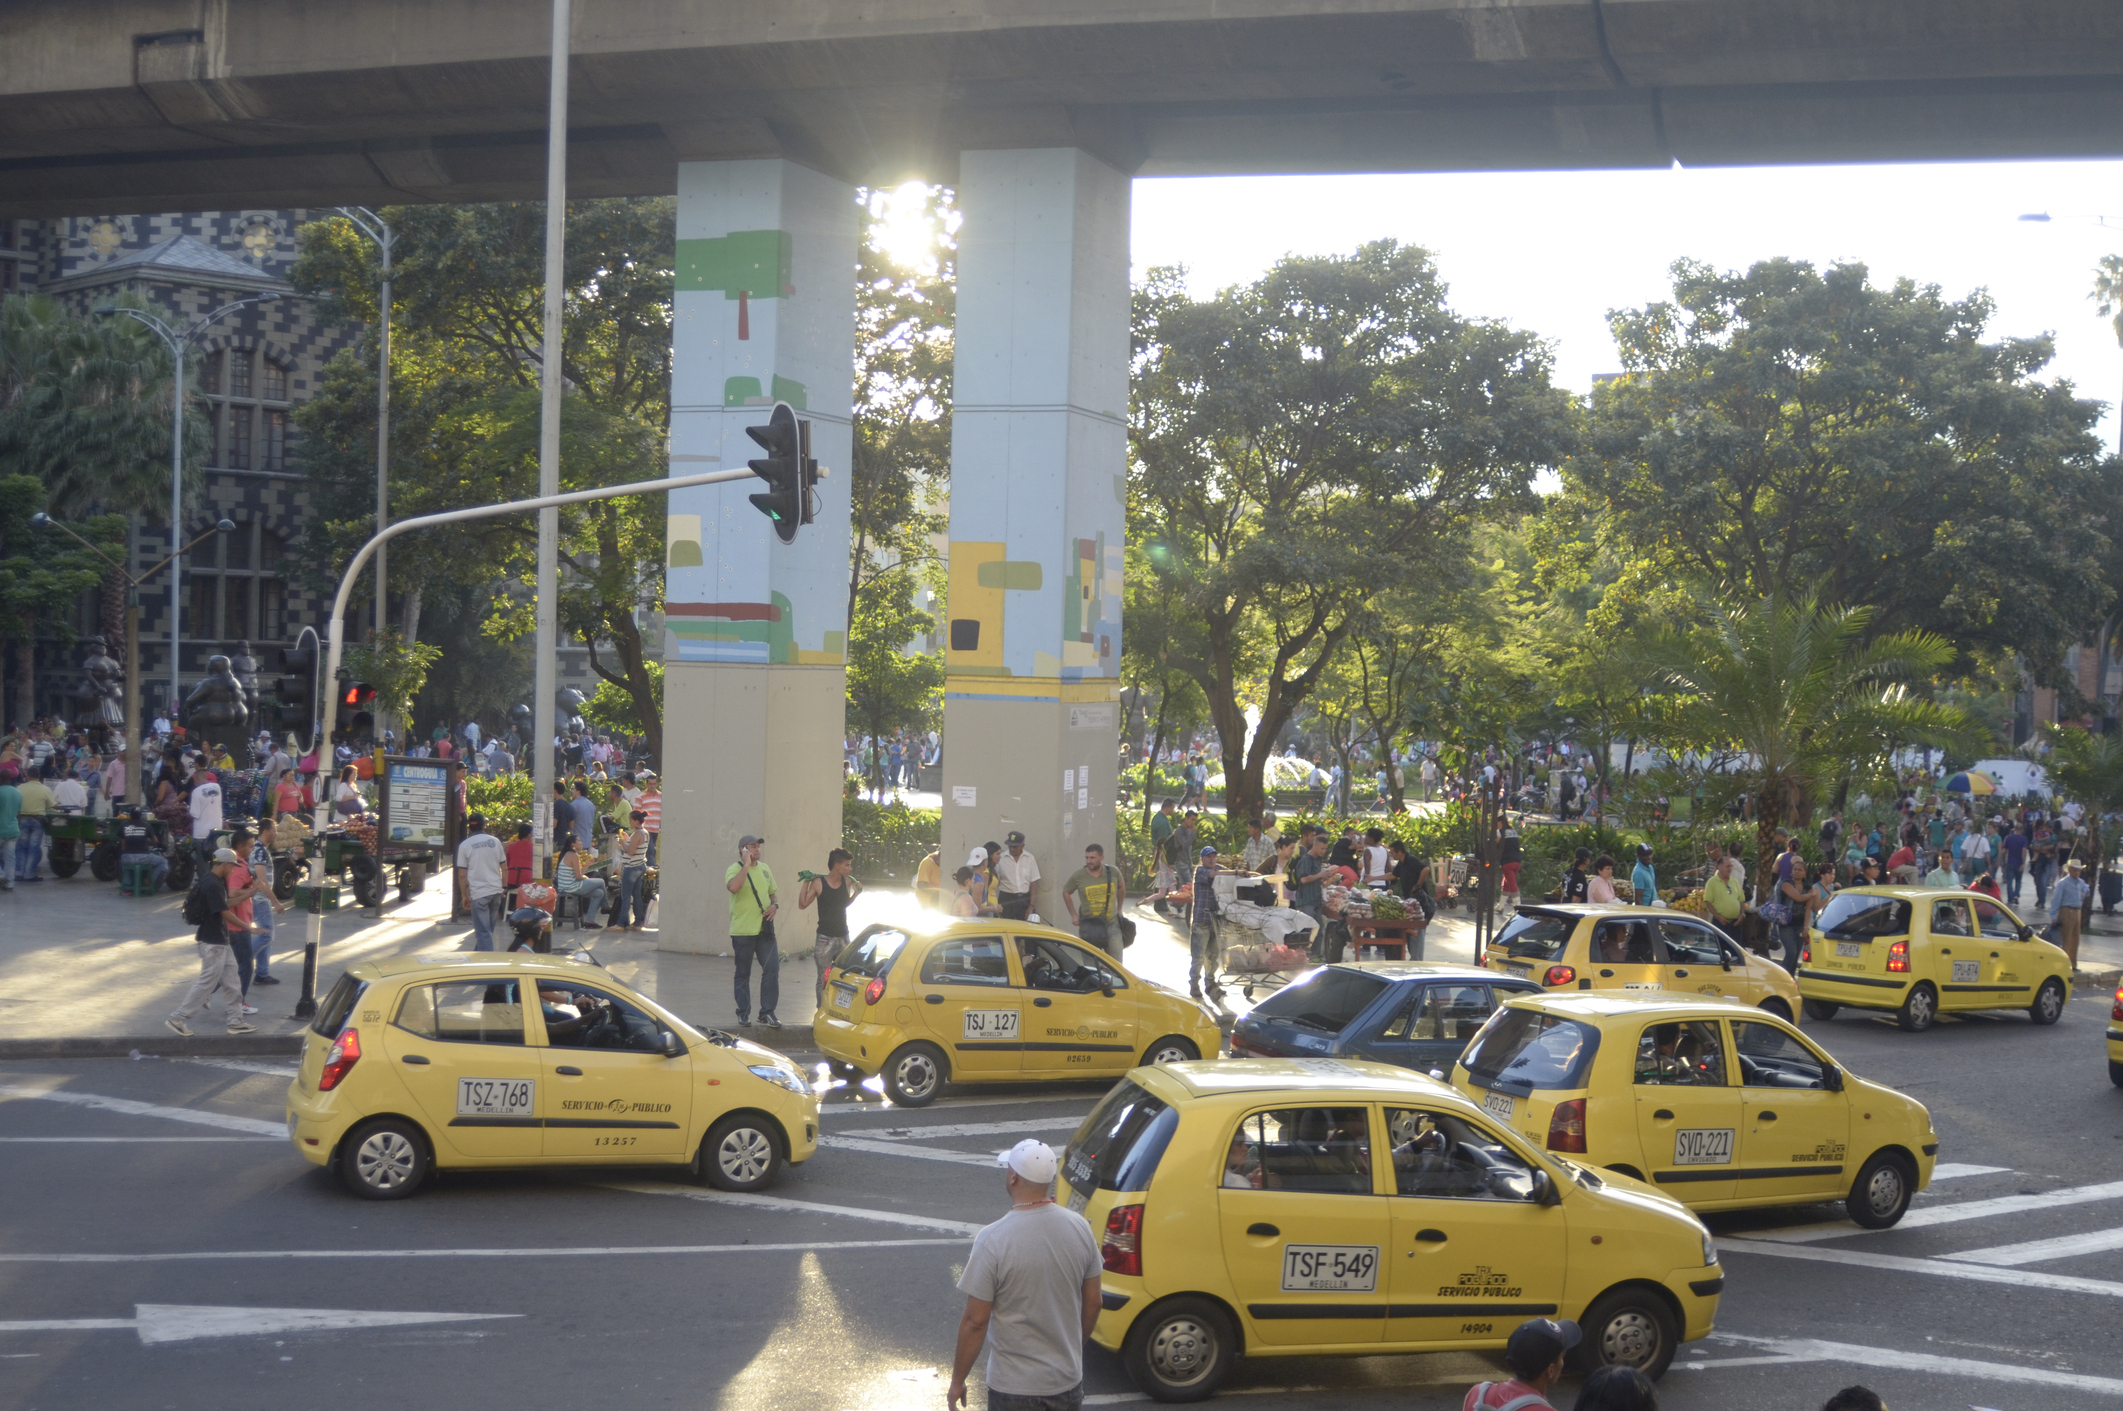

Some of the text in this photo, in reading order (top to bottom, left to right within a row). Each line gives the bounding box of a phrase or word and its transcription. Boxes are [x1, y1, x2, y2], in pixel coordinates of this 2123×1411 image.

[1576, 883, 1584, 892] 3
[1046, 1028, 1118, 1039] SERVICIO PUBLICO
[1066, 1055, 1092, 1063] 02659
[477, 1106, 514, 1114] MEDELLIN
[562, 1100, 604, 1111] SERVICIO
[631, 1102, 671, 1113] PUBLICO
[594, 1137, 637, 1146] 13257
[1457, 1273, 1508, 1285] POBLADO
[1308, 1280, 1348, 1289] MEDELLIN
[1437, 1286, 1522, 1298] SERVICIO PUBLICO
[1460, 1323, 1493, 1334] 14904
